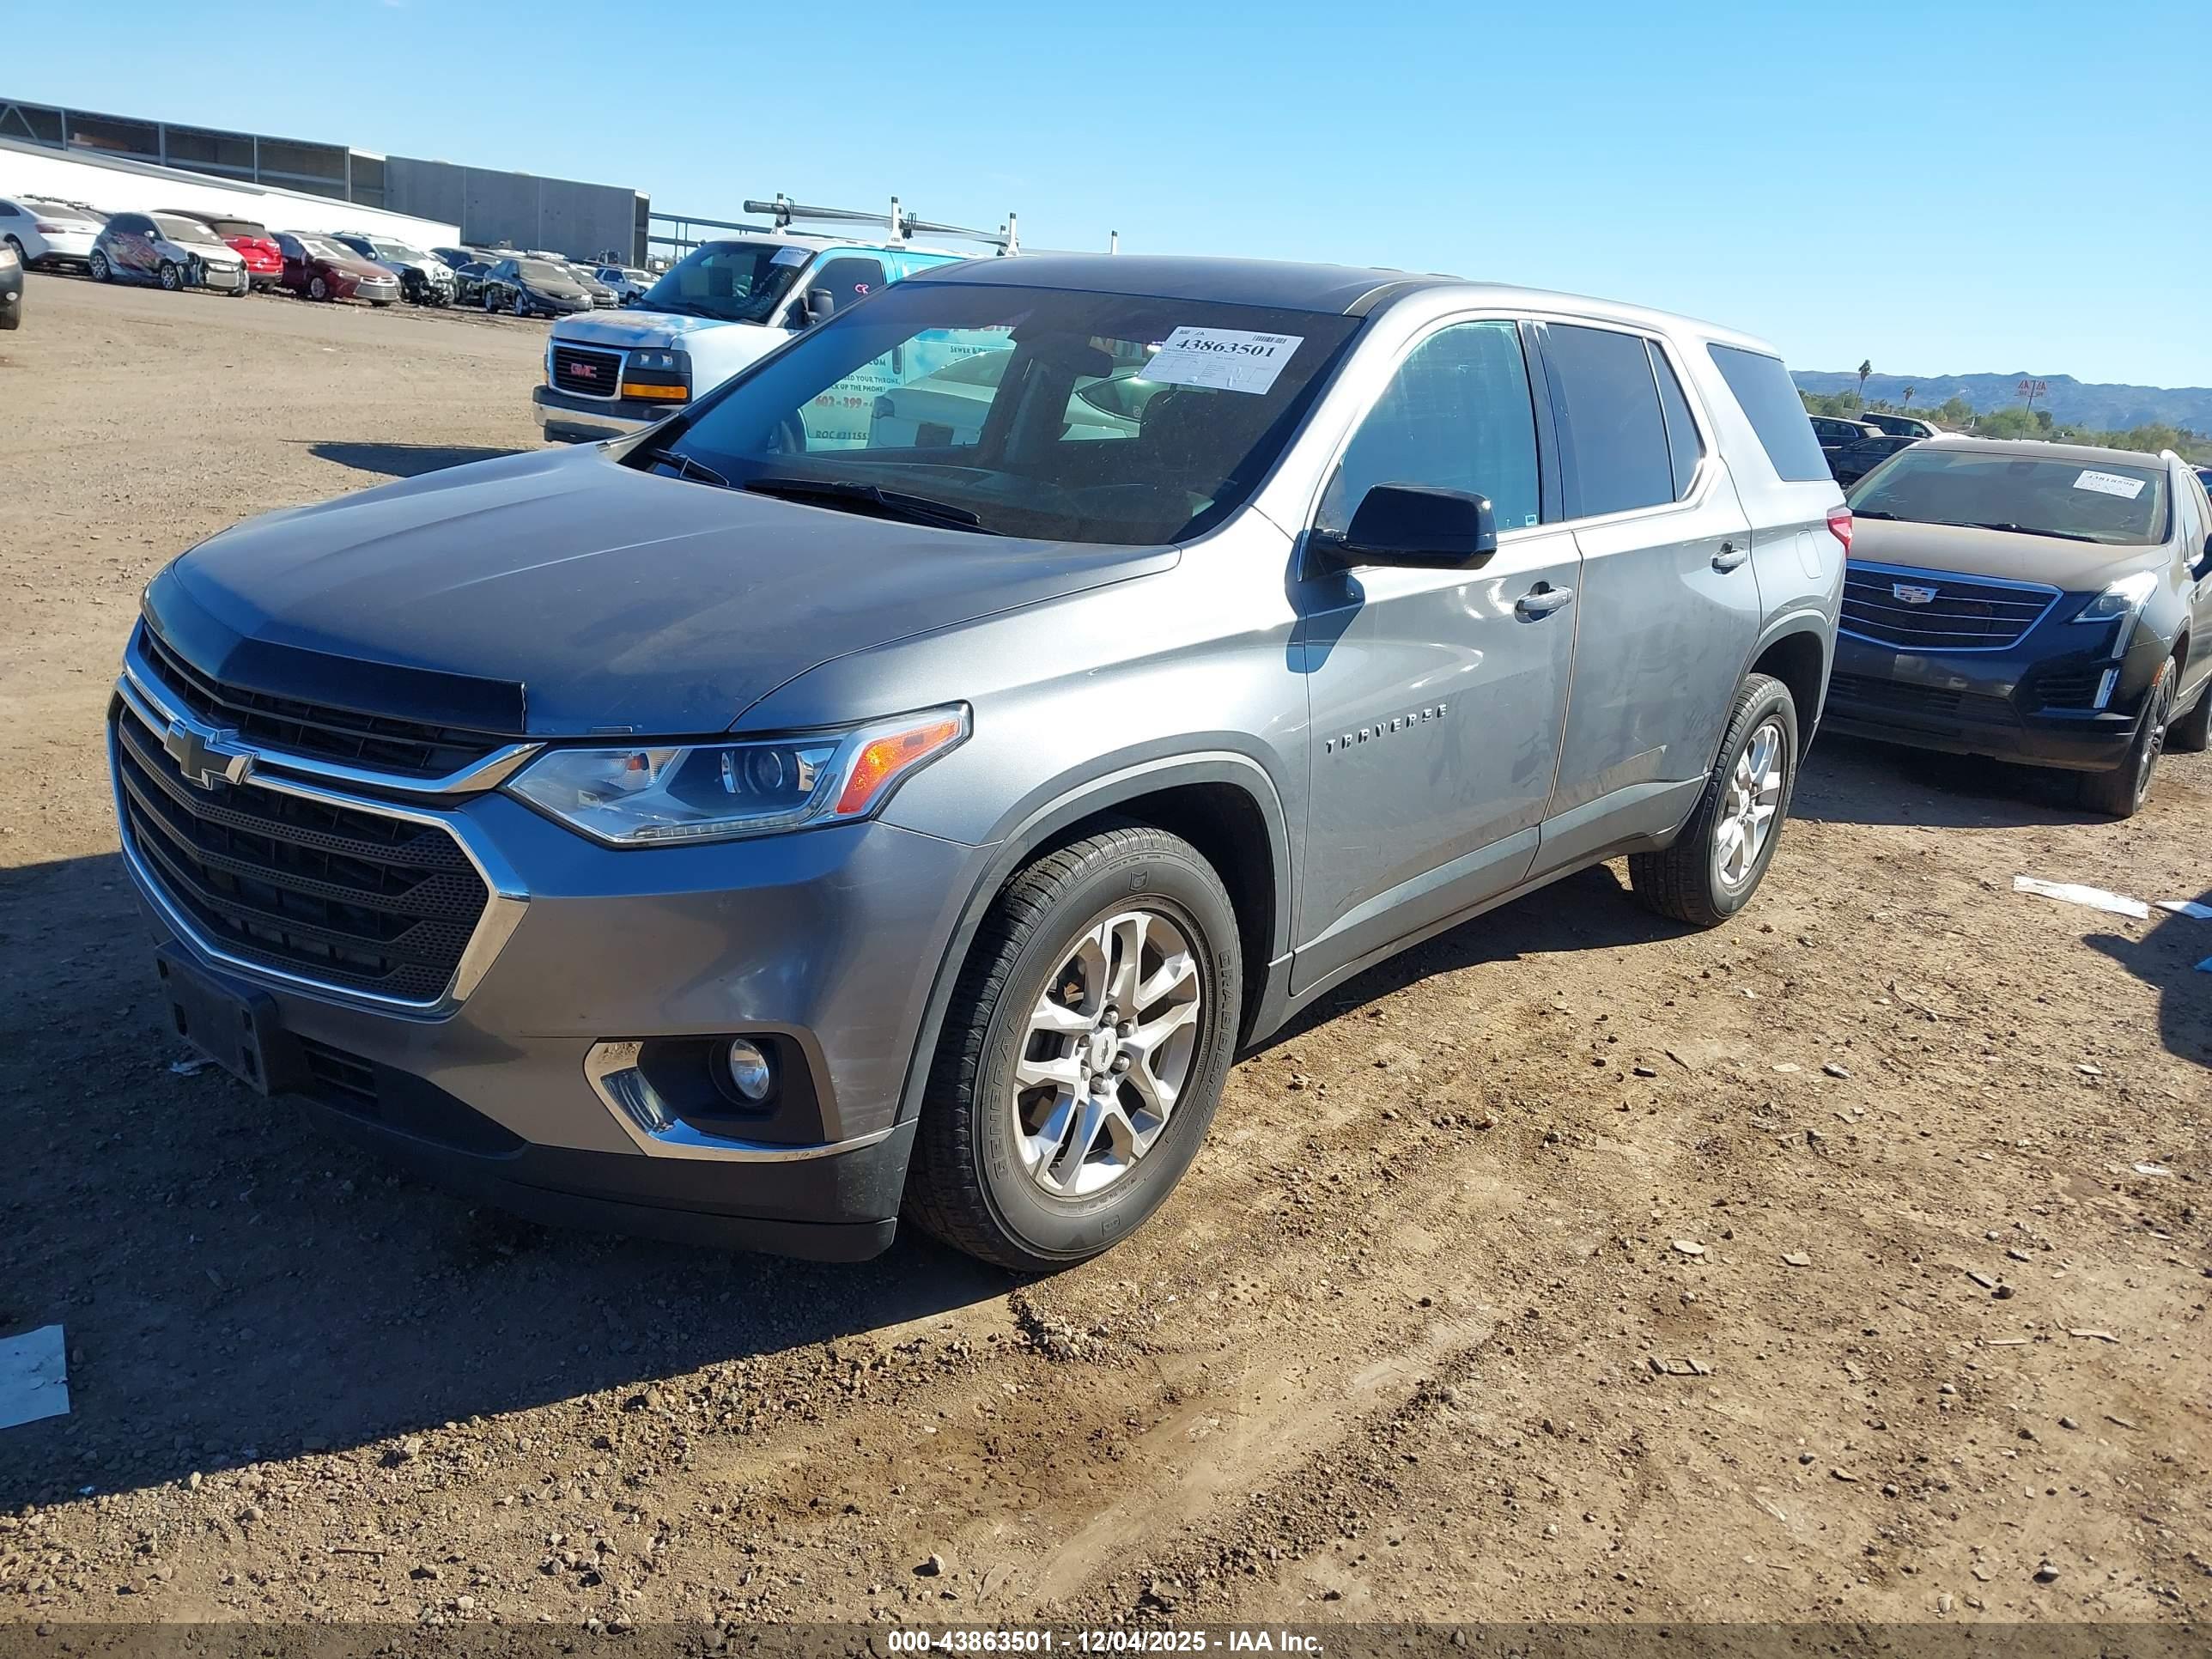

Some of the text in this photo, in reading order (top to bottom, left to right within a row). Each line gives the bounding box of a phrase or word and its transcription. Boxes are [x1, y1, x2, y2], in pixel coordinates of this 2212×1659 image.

[570, 362, 597, 379] GMC
[1176, 338, 1276, 358] 43863501
[1325, 703, 1447, 754] TRAVERSE
[1206, 950, 1232, 1098] GRABBER
[989, 1012, 1025, 1181] GENERAL
